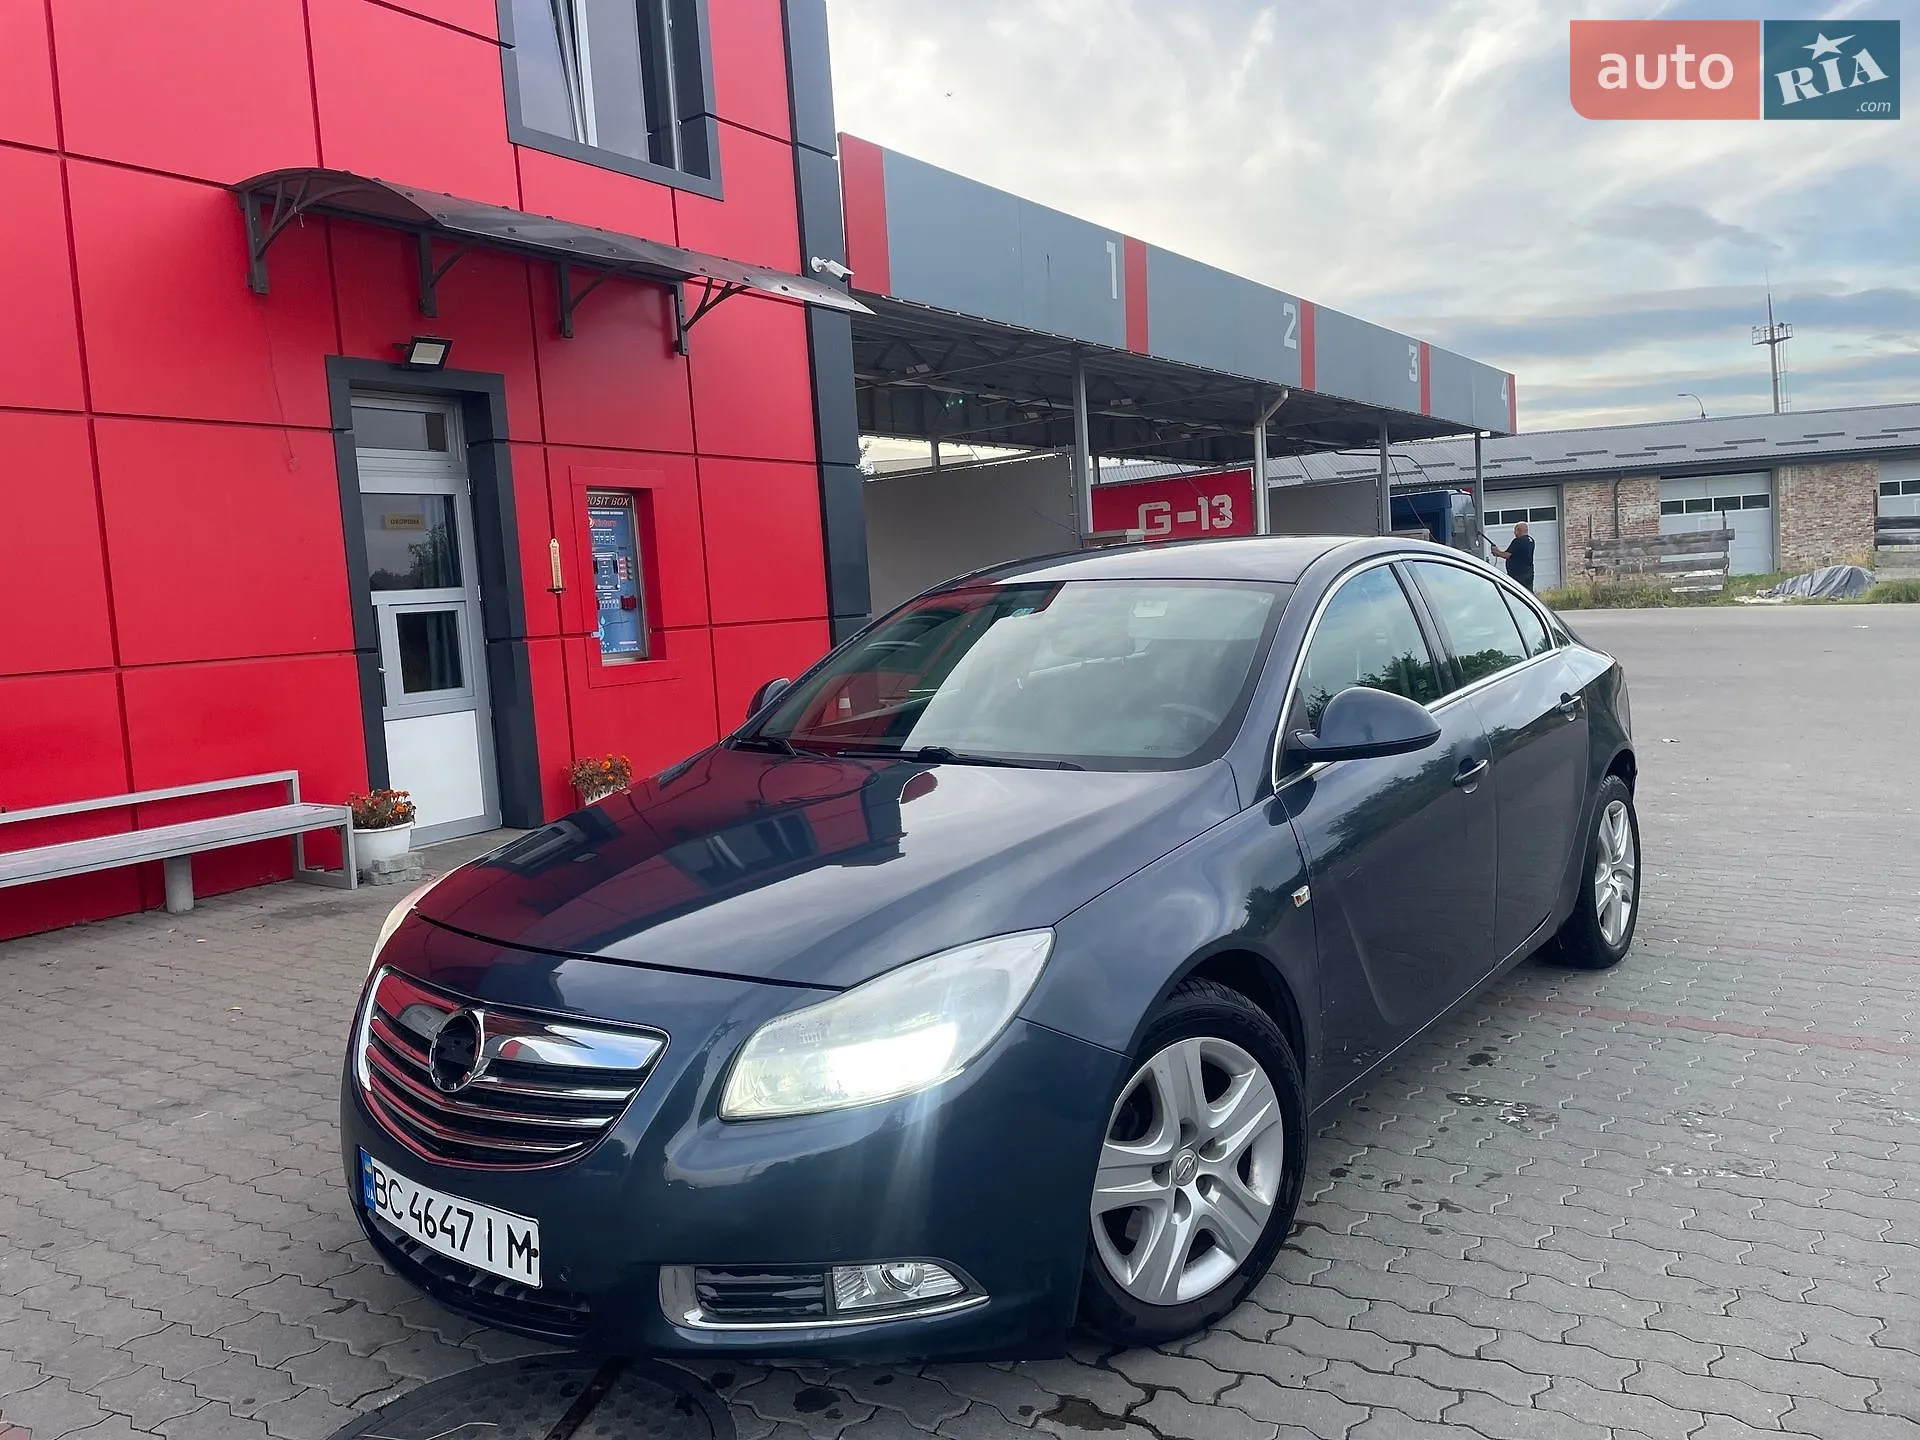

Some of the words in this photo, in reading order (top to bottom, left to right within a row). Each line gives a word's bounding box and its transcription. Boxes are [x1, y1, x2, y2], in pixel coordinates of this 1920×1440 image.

[1106, 241, 1118, 300] 1
[1283, 302, 1298, 350] 2
[1408, 344, 1419, 383] 3
[1500, 376, 1508, 406] 4
[611, 497, 629, 506] BOX
[1138, 494, 1233, 536] G-13
[365, 1185, 375, 1202] UA
[373, 1167, 403, 1219] BC
[409, 1191, 475, 1252] 4647
